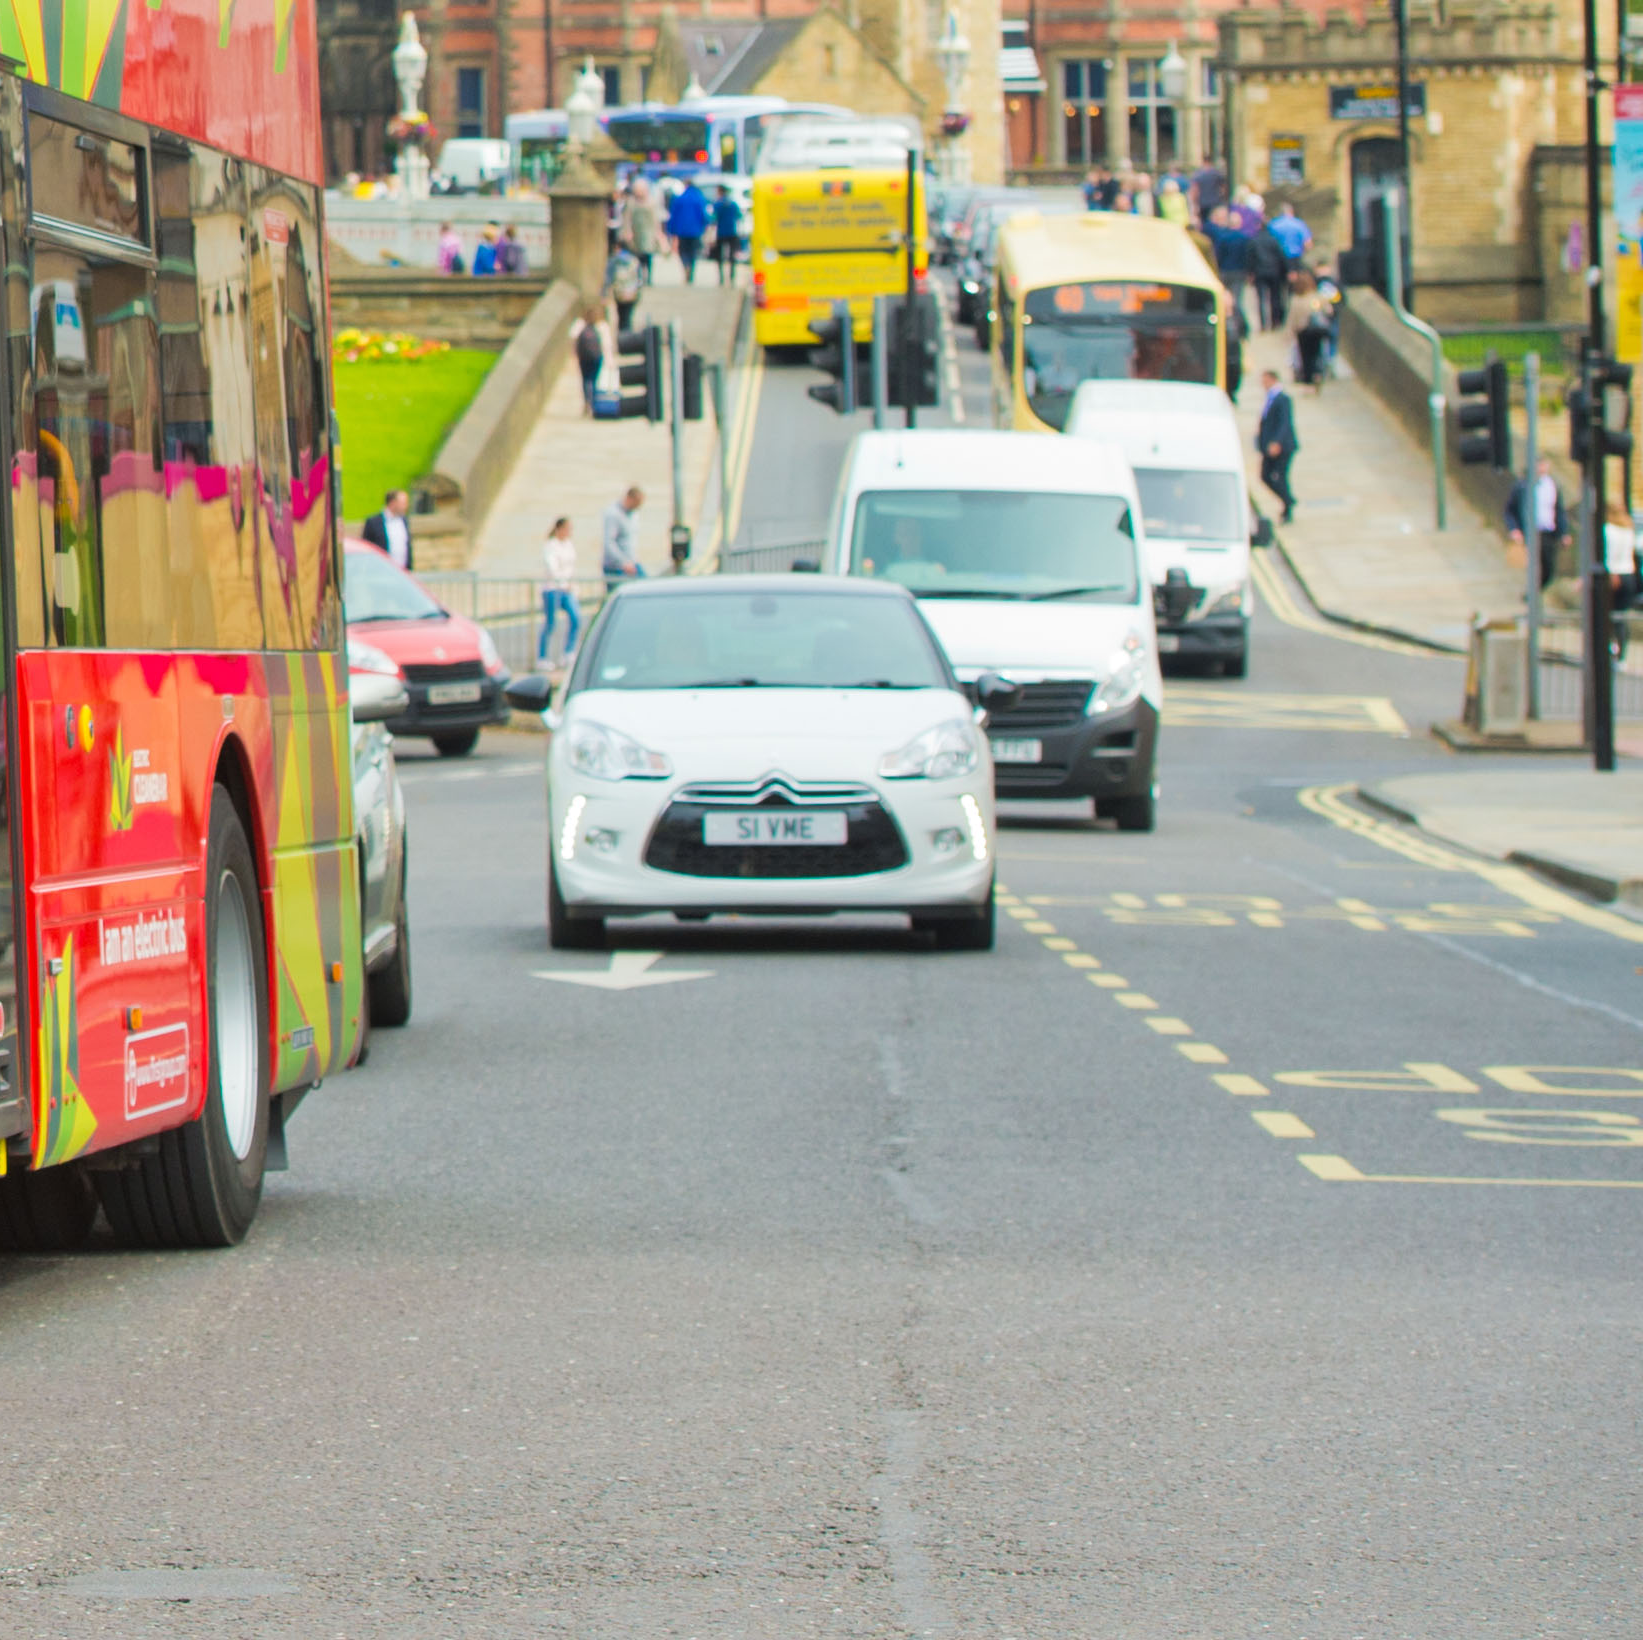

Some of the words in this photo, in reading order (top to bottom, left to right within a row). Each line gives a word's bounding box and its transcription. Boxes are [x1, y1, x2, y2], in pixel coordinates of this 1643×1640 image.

[766, 817, 815, 839] VME
[135, 910, 169, 960] electric
[168, 907, 188, 954] bus
